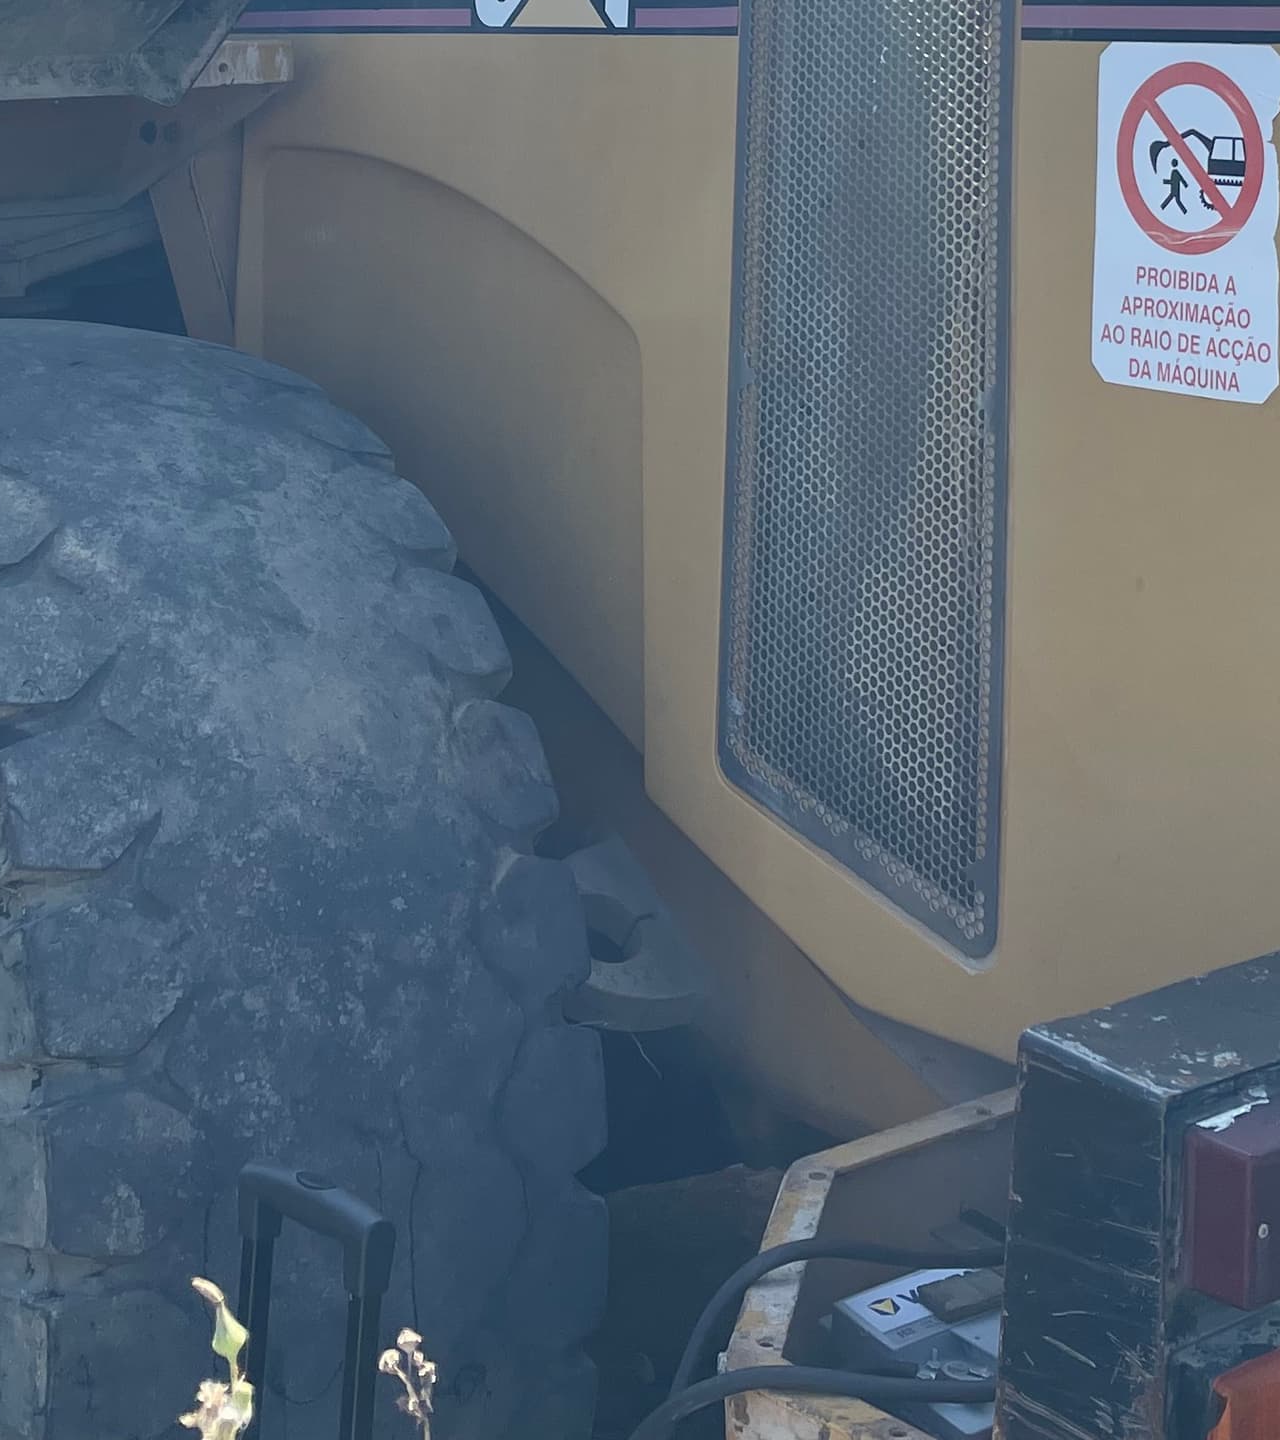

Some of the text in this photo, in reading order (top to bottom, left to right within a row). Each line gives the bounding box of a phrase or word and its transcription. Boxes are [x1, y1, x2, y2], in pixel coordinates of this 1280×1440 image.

[1136, 266, 1238, 296] PROIBIDA A
[1120, 295, 1252, 332] APROXIMAÇÃO
[1100, 323, 1272, 367] AO RAIO DE ACÇÃO
[1129, 358, 1240, 393] DA MÁQUINA
